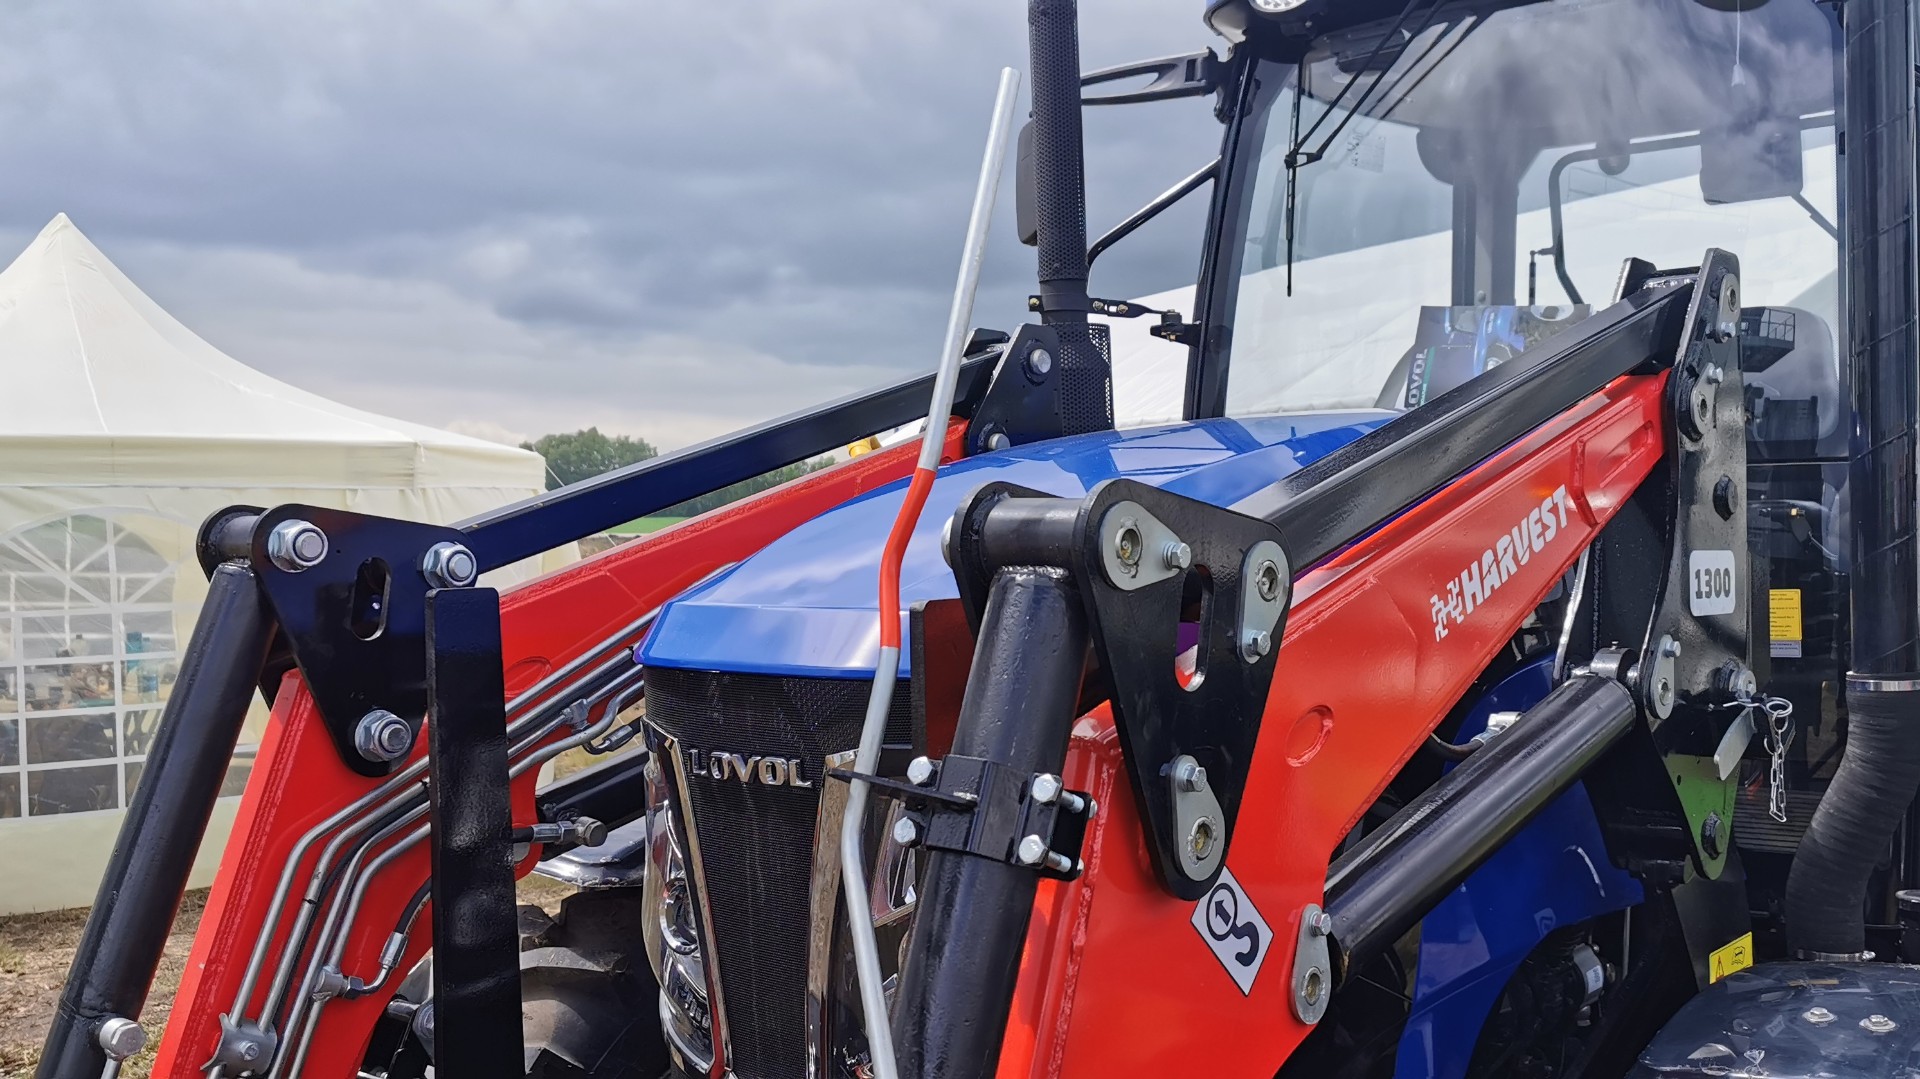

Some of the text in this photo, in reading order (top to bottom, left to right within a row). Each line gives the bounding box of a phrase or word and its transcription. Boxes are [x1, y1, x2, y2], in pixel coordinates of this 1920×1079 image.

[1461, 484, 1568, 615] HARVEST
[1695, 567, 1731, 600] 1300
[688, 749, 813, 787] LOVOL
